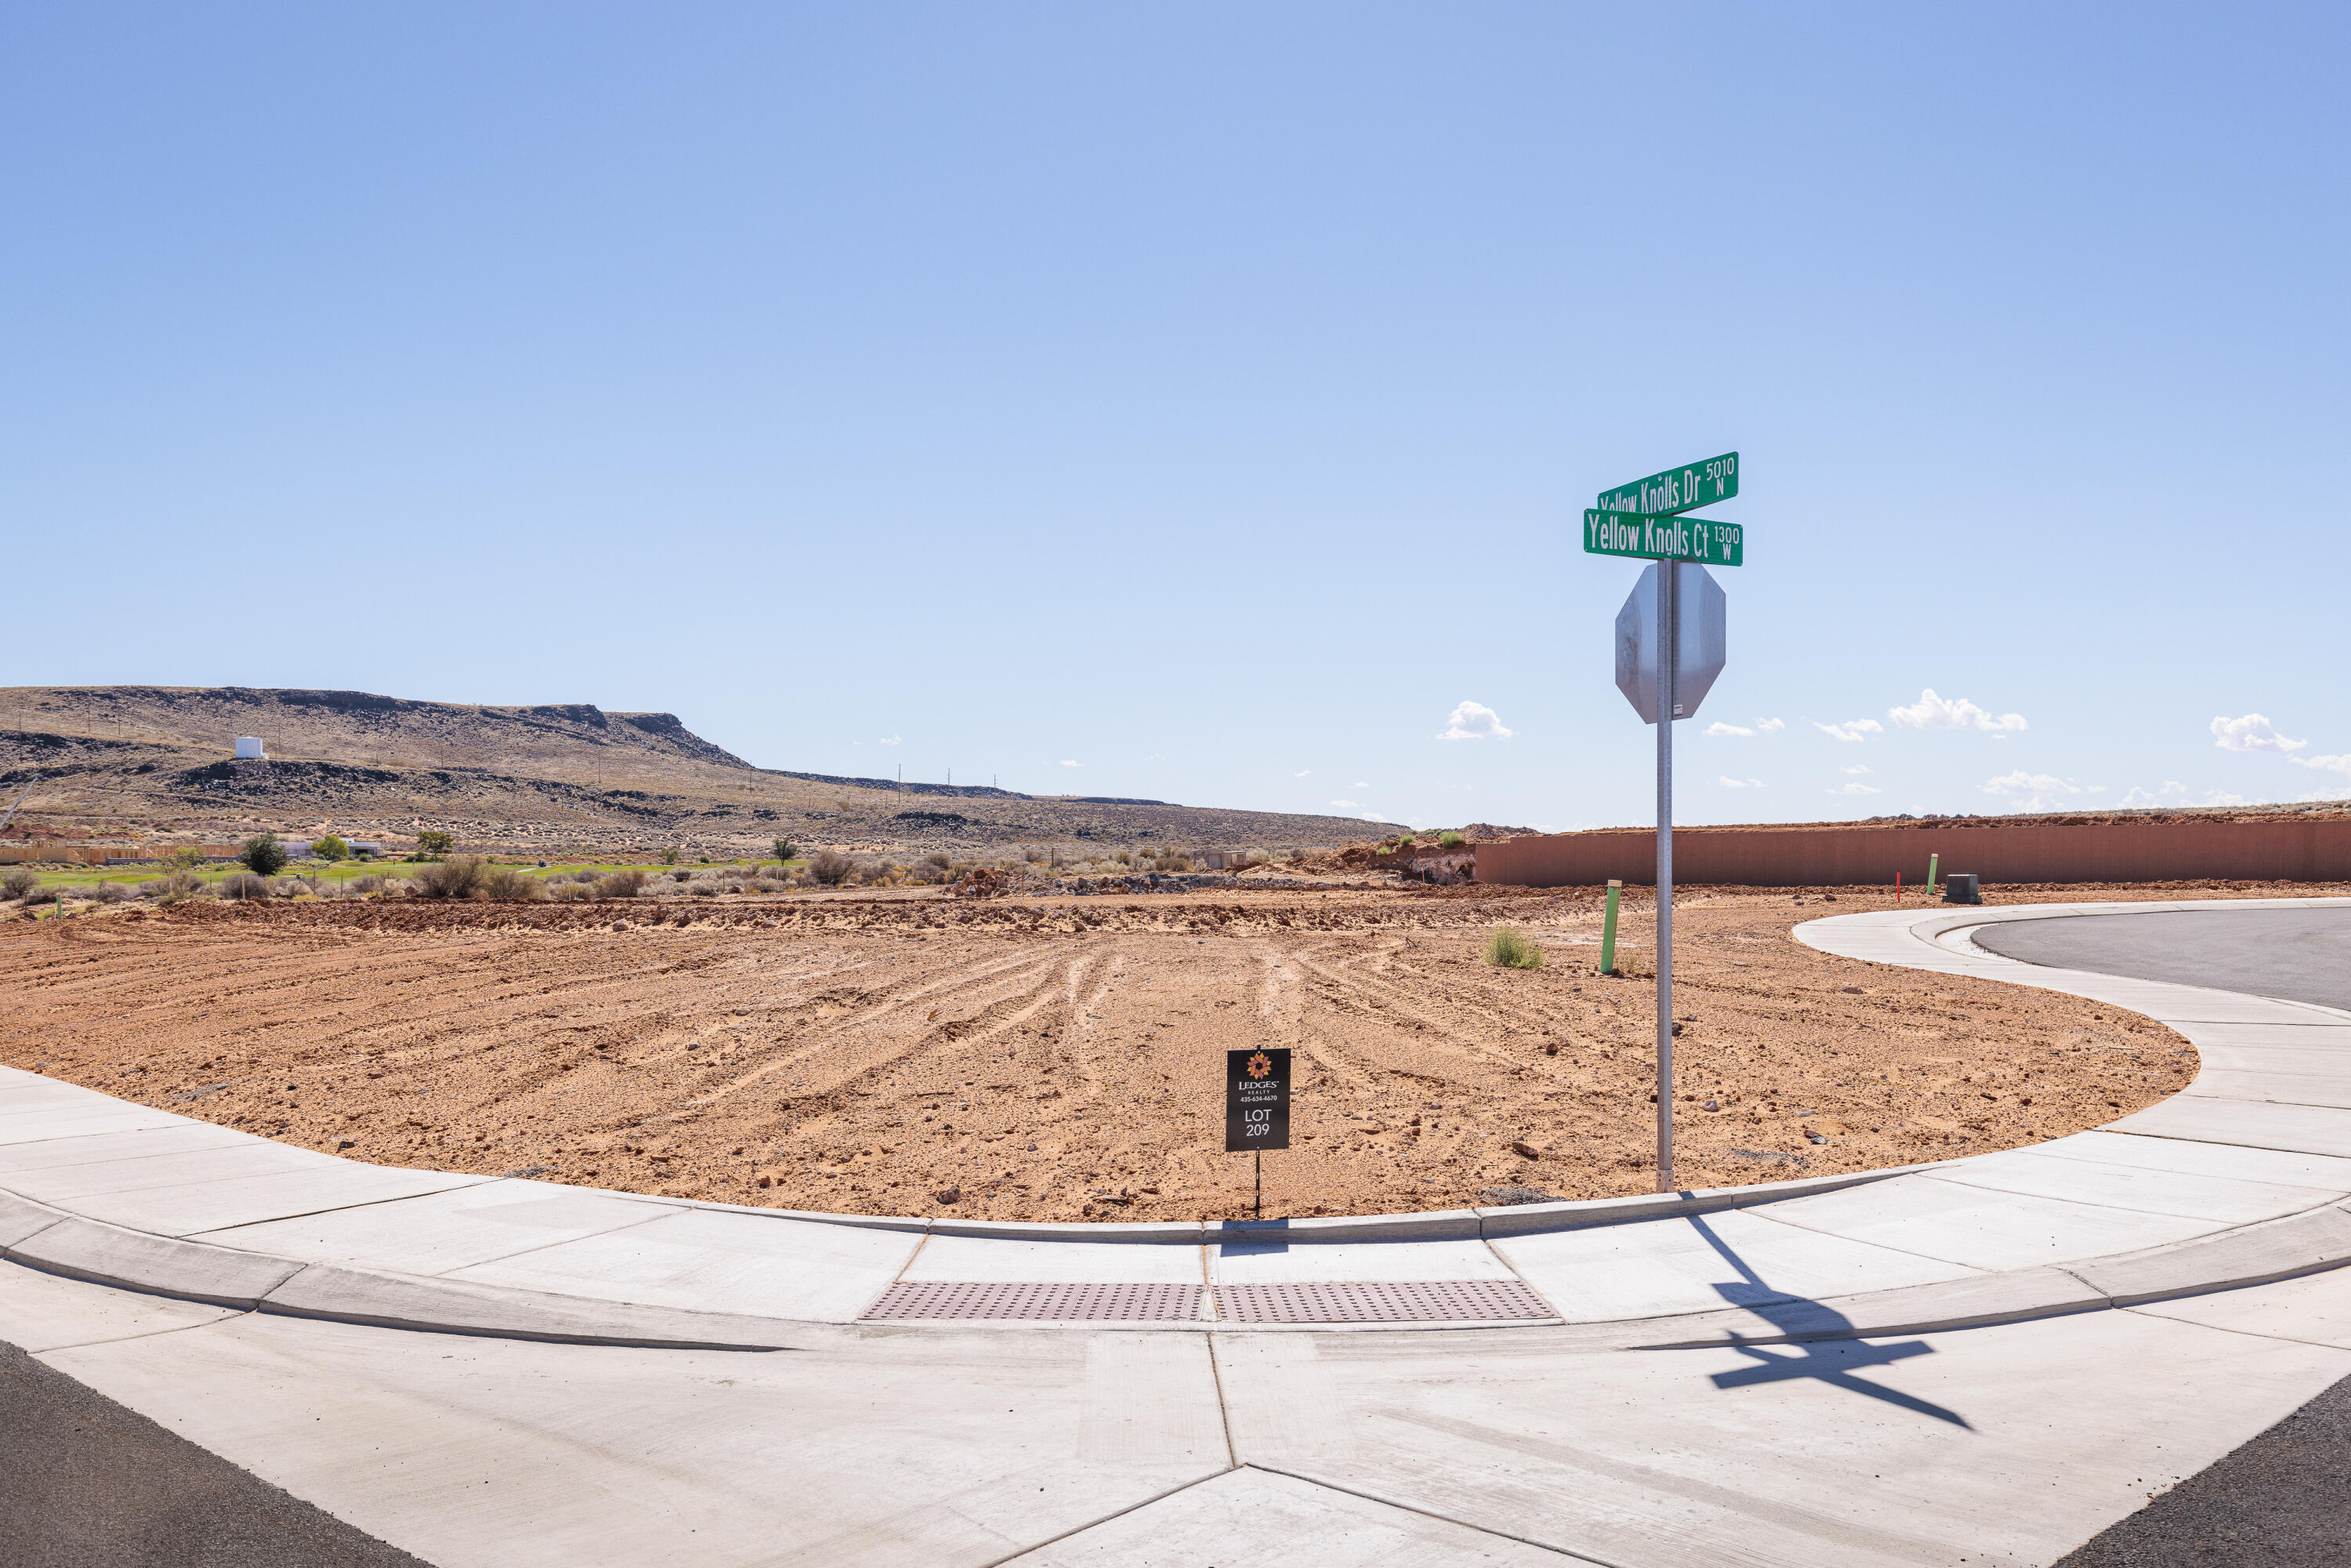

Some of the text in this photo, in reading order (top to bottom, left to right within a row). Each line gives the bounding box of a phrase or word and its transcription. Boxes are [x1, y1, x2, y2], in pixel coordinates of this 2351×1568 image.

[1706, 457, 1734, 481] 5010
[1641, 475, 1679, 514] Knolls
[1684, 469, 1701, 504] Dr
[1716, 477, 1724, 496] N
[1588, 513, 1708, 558] Yellow Knolls Ct
[1715, 526, 1740, 545] 1300
[1722, 543, 1732, 560] W
[1244, 1109, 1272, 1122] LOT
[1246, 1123, 1270, 1136] 209
